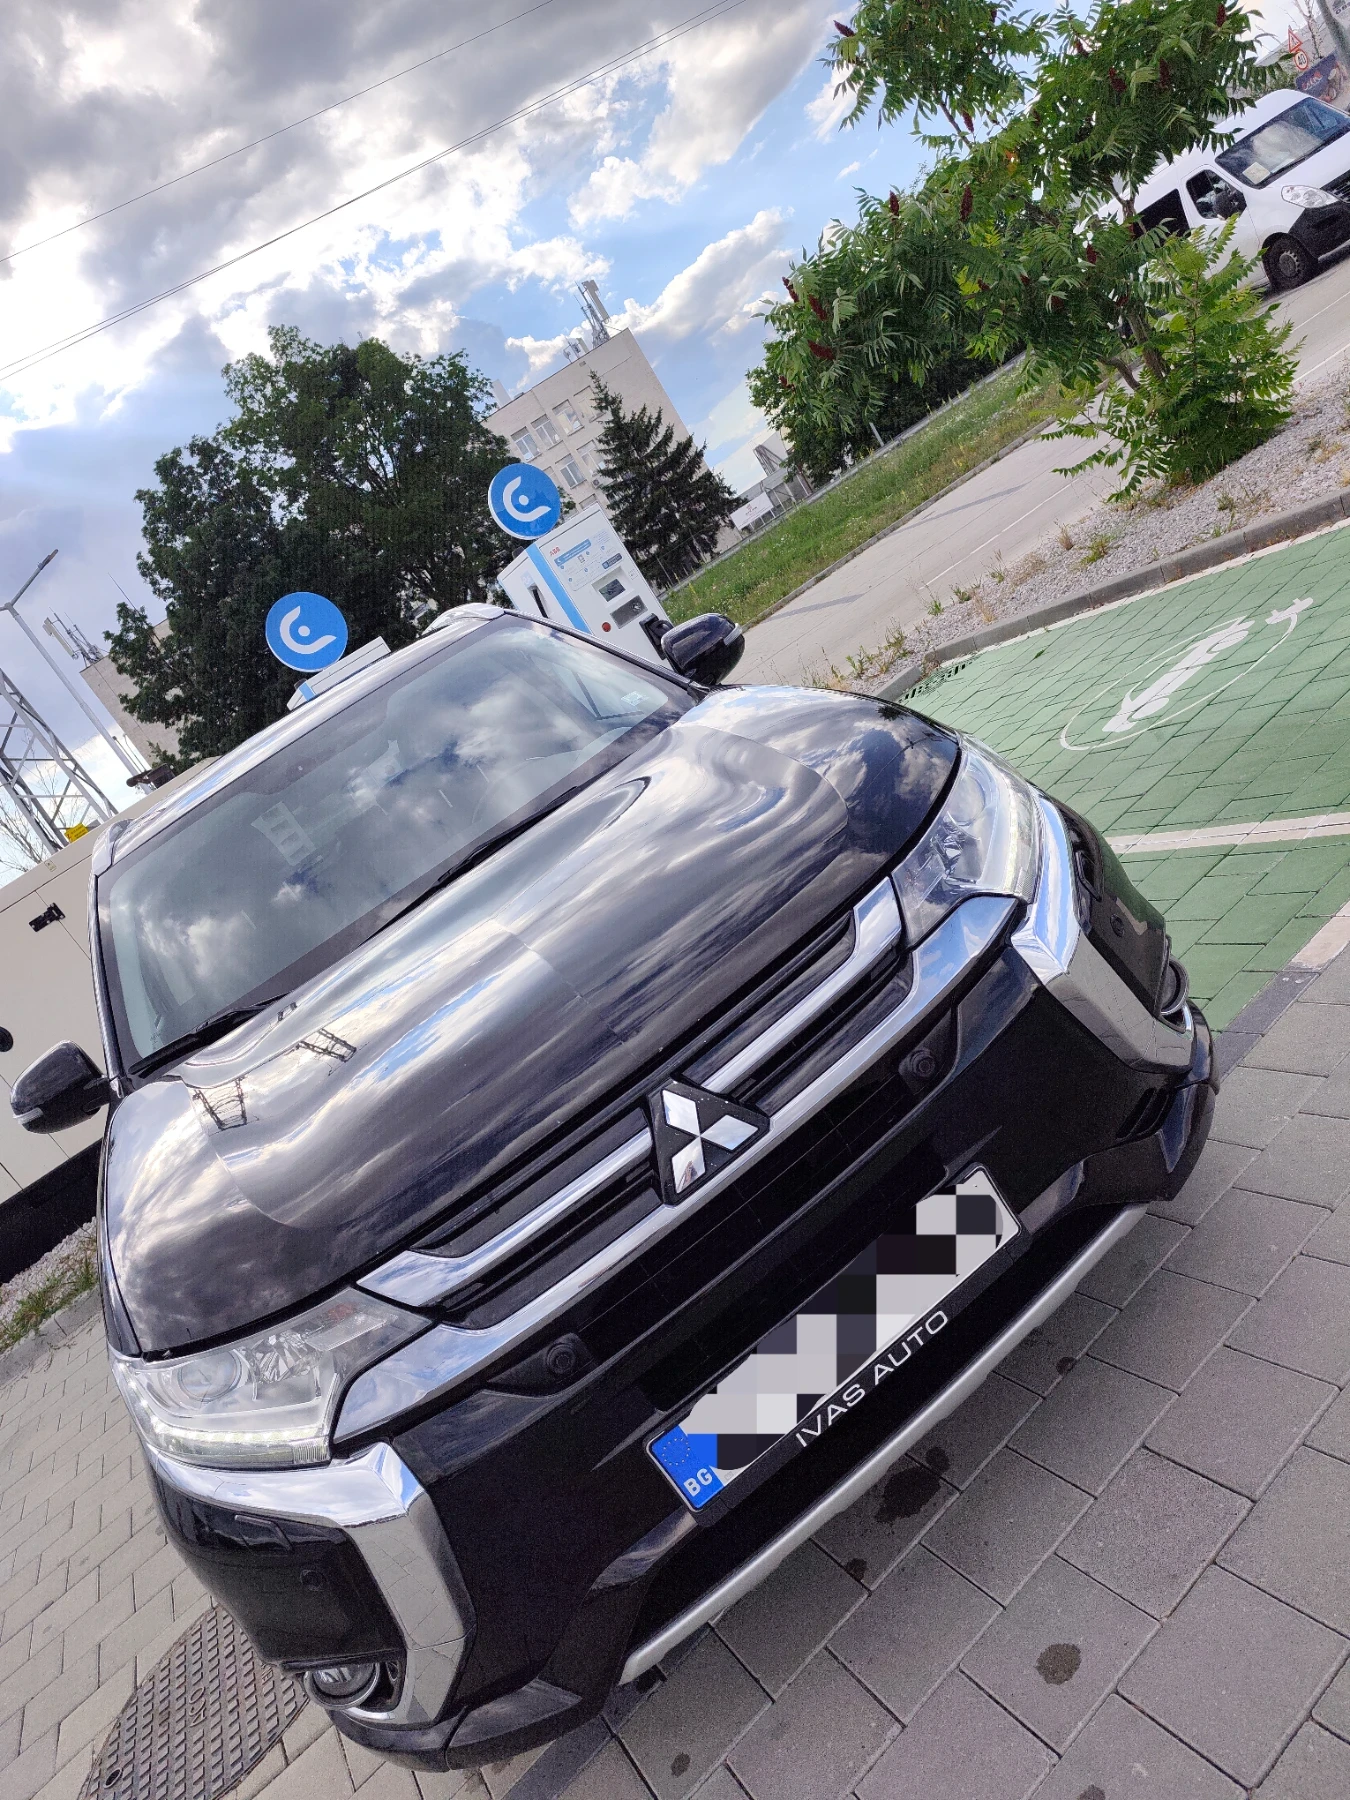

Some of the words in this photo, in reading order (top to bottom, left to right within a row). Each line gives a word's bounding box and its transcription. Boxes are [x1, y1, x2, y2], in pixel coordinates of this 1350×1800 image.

[1297, 54, 1306, 65] 40
[549, 546, 561, 556] ABB
[795, 1383, 866, 1447] IVAS
[873, 1310, 949, 1385] AUTO
[683, 1467, 713, 1497] BG
[189, 1687, 207, 1727] ACO
